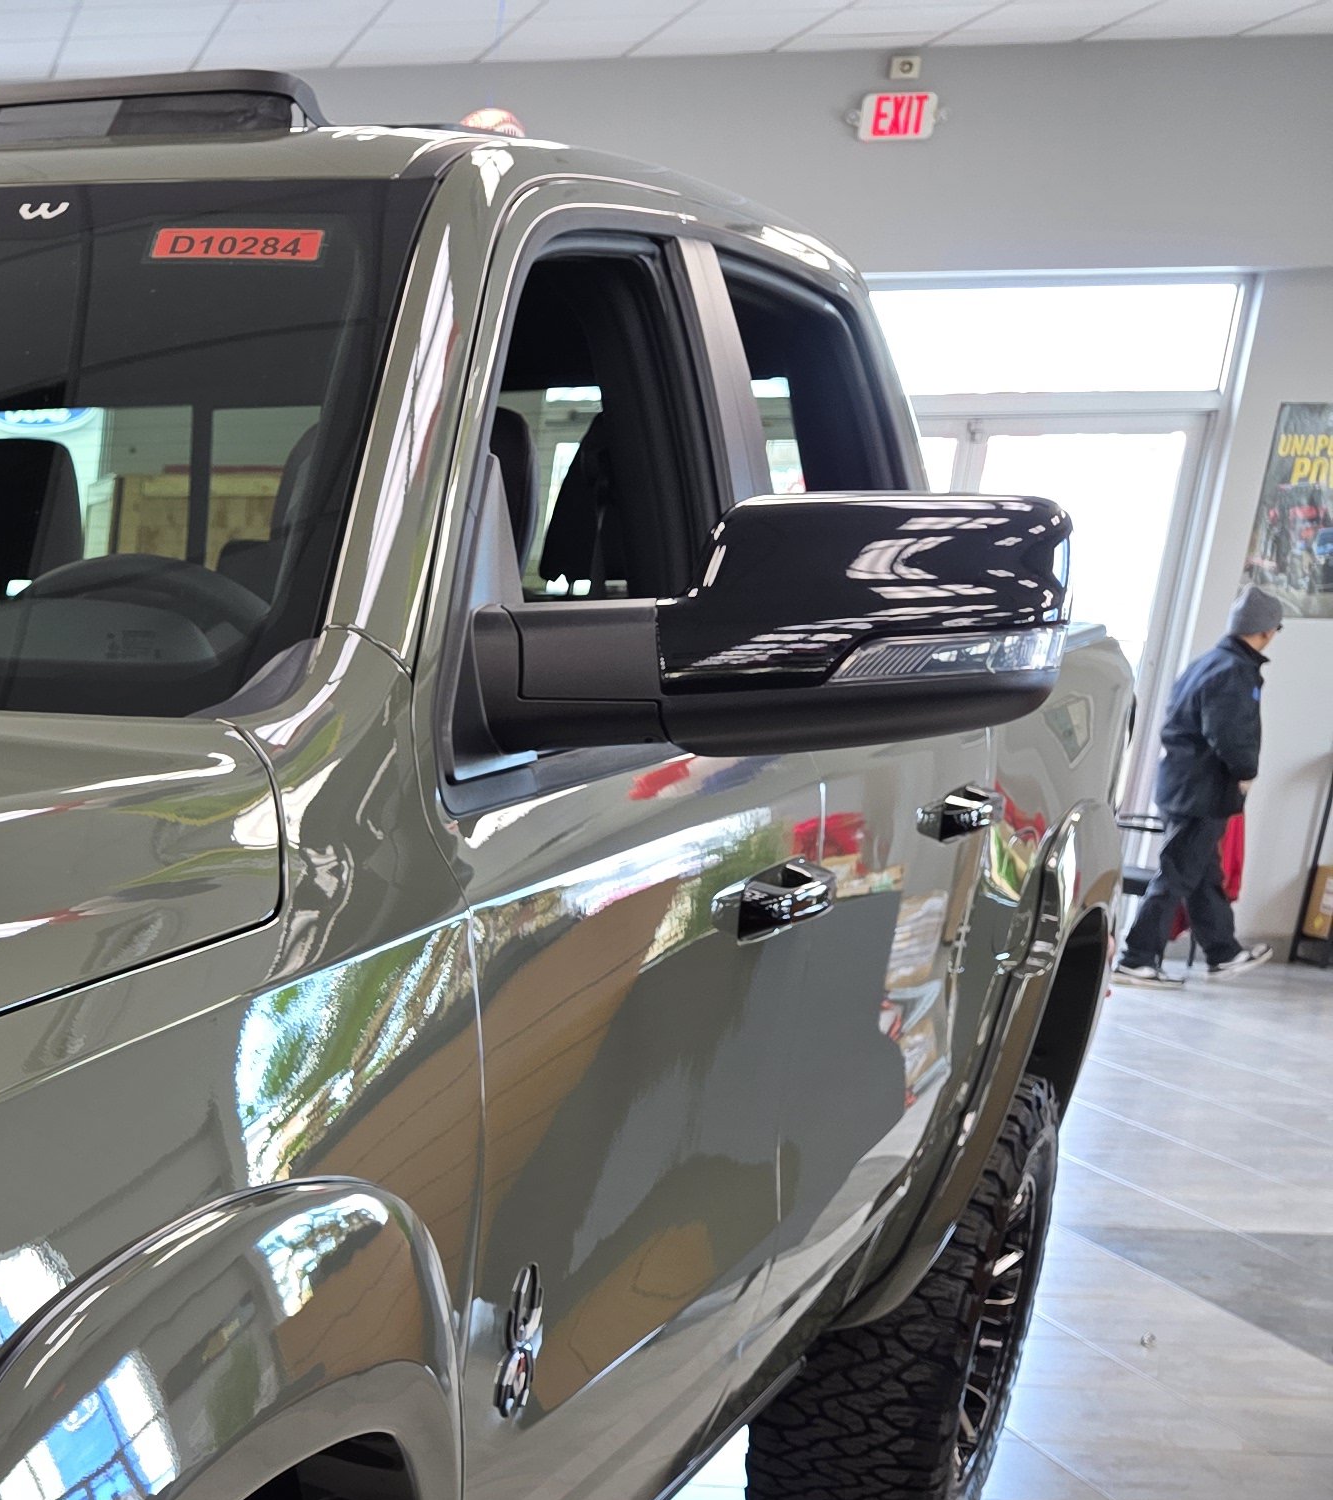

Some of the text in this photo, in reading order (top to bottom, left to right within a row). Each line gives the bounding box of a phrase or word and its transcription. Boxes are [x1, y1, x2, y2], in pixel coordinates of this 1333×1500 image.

[872, 94, 930, 136] EXIT
[169, 235, 302, 257] D10284
[1277, 433, 1333, 458] UNAP
[1289, 457, 1333, 487] PO
